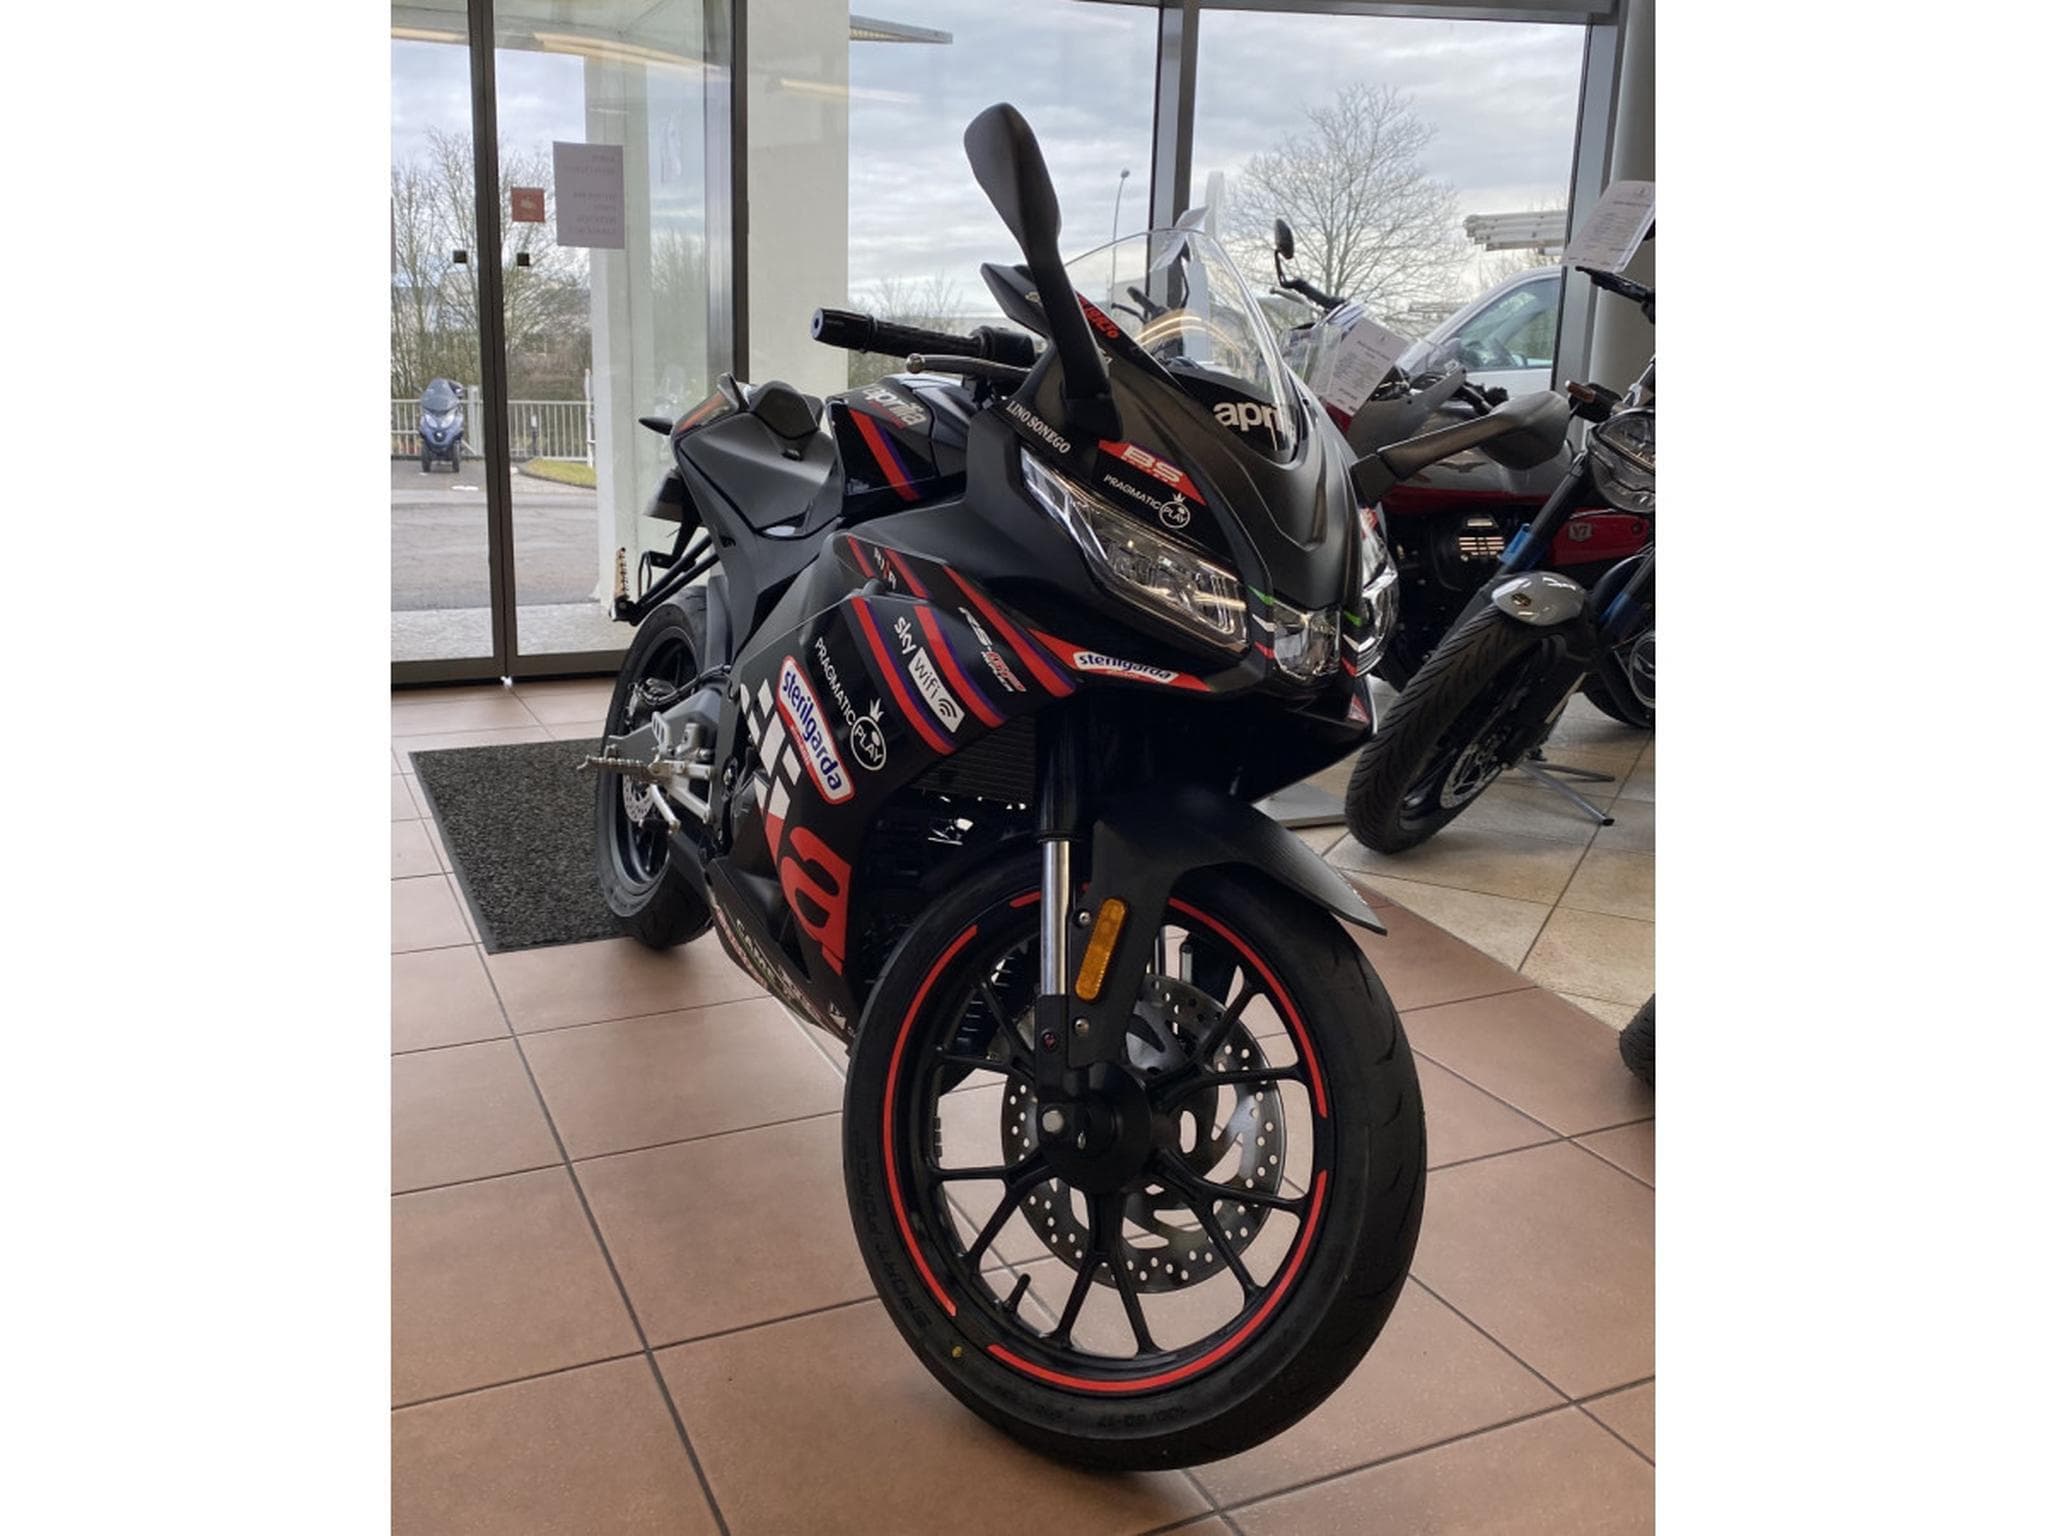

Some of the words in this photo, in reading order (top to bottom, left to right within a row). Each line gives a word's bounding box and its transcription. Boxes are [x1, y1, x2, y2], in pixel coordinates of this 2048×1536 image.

[1006, 400, 1032, 422] LINO
[1026, 416, 1072, 454] SONEGO
[1122, 444, 1185, 484] BS
[1103, 473, 1162, 510] PRAGMATIC
[1163, 505, 1188, 524] PLAY
[894, 616, 917, 655] sky
[914, 657, 942, 698] wifi
[781, 670, 842, 791] sterilgarda
[814, 636, 857, 727] PRAGMATIC
[853, 724, 884, 763] PLAY
